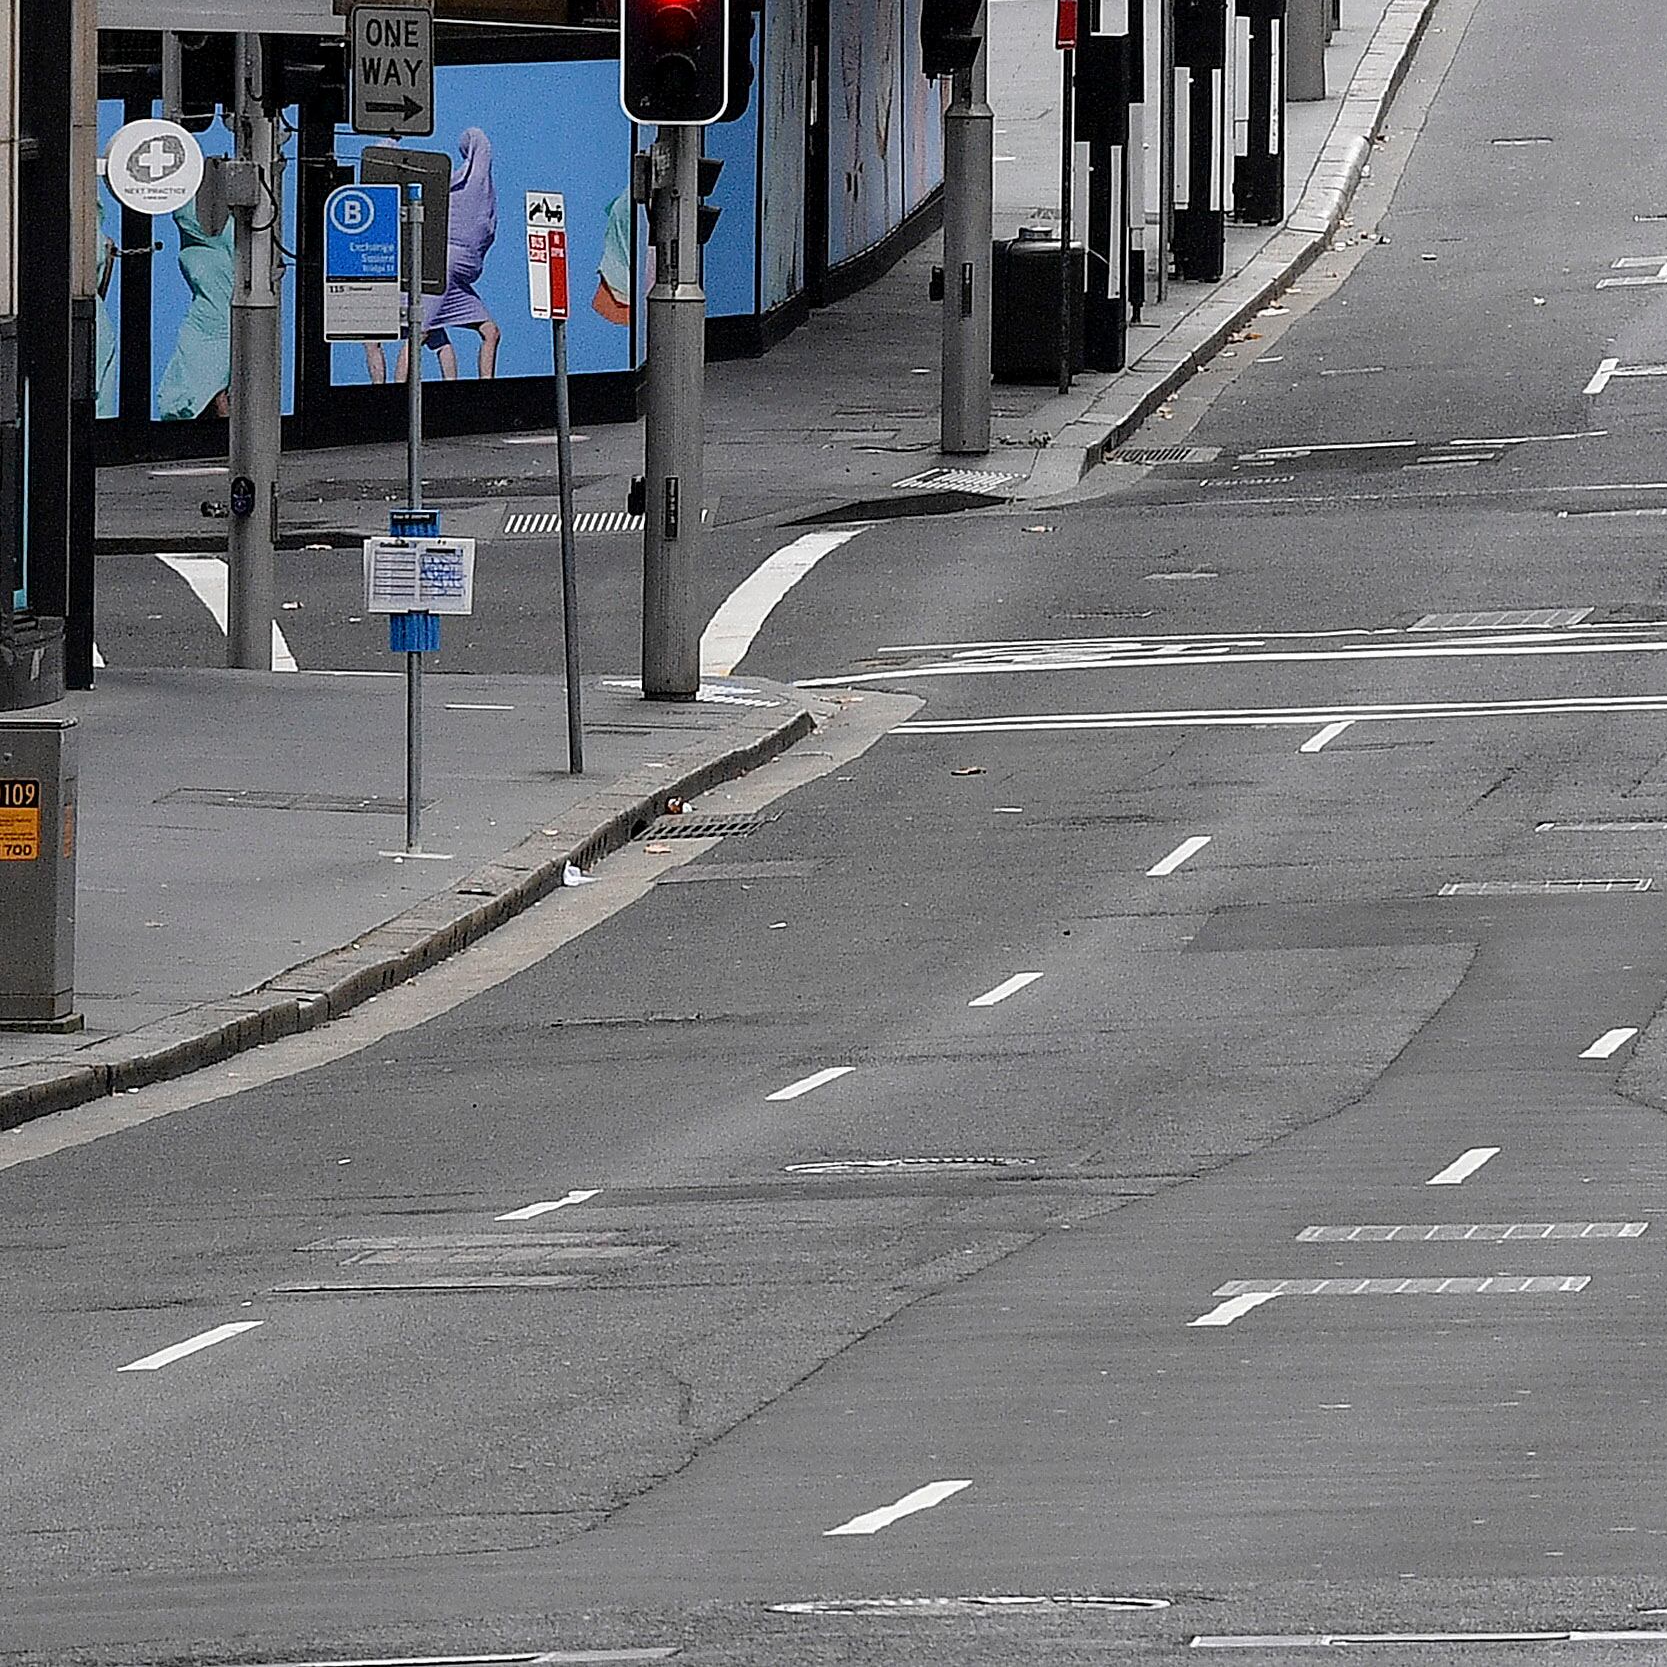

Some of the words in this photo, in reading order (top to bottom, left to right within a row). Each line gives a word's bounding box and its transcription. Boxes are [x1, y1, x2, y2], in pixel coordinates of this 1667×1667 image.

[366, 18, 418, 47] ONE
[361, 57, 423, 87] WAY
[344, 200, 361, 224] B
[329, 285, 345, 294] 115
[0, 783, 35, 806] 109
[4, 844, 33, 857] 700
